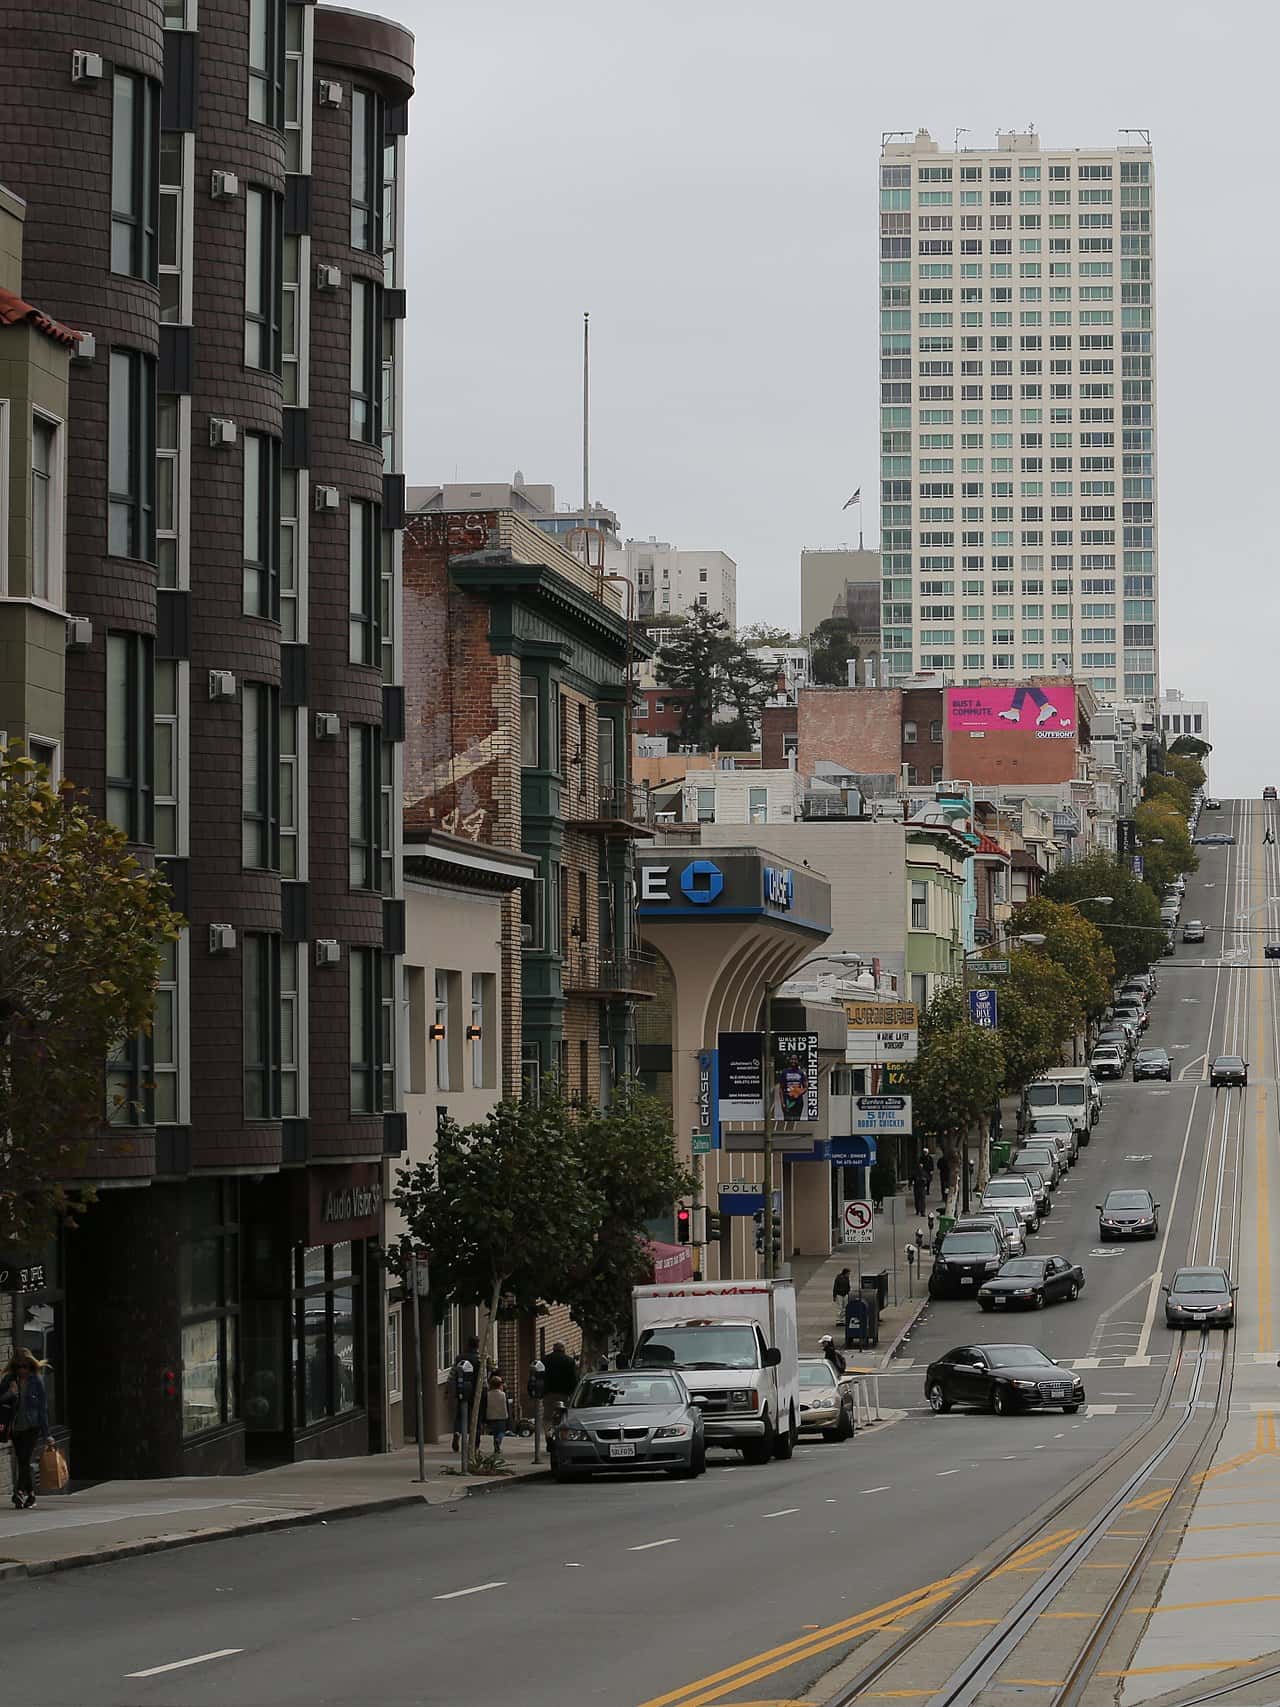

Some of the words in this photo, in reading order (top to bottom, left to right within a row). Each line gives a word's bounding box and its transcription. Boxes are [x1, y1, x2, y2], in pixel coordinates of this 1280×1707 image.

[952, 708, 993, 716] COMMUTE
[846, 1007, 915, 1025] LUMIERE
[778, 1042, 807, 1051] END
[807, 1035, 818, 1117] ALZHEIMER'S
[700, 1071, 710, 1127] CHASE
[867, 1111, 875, 1119] 5
